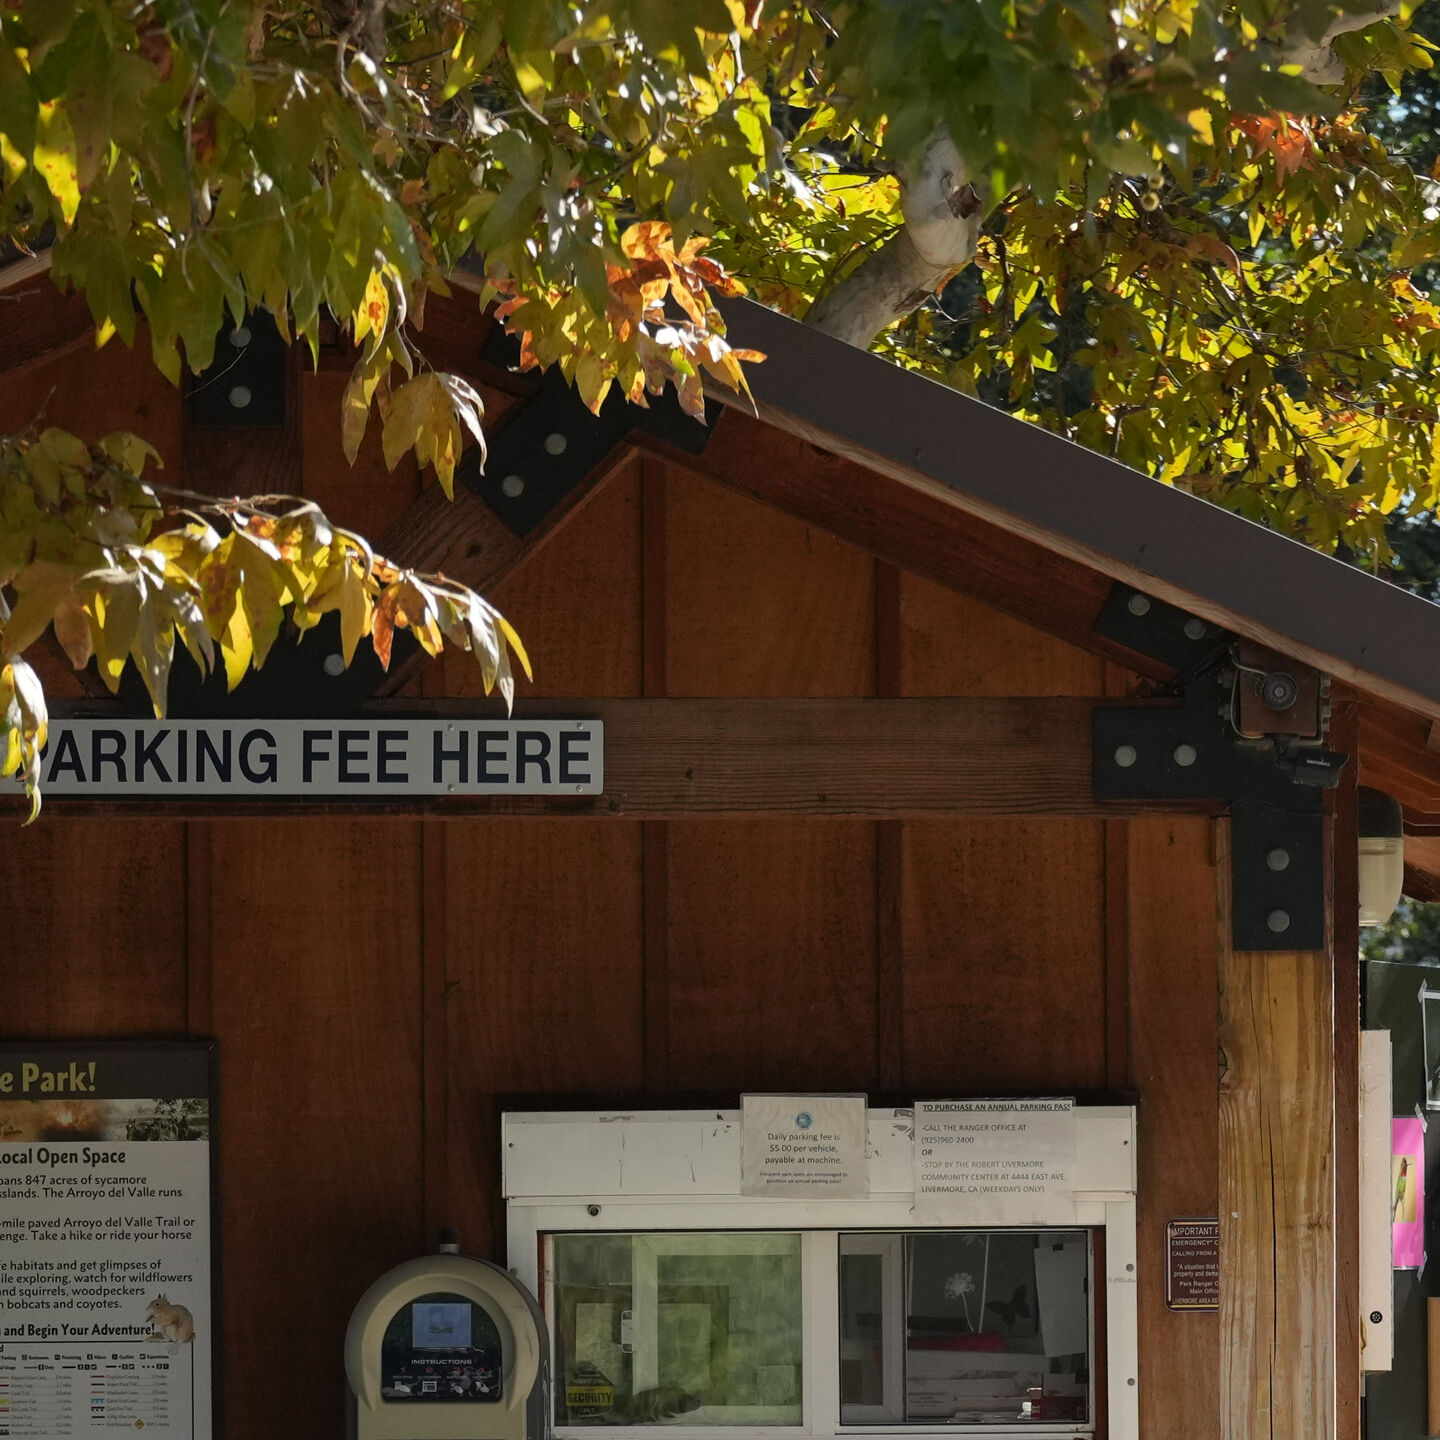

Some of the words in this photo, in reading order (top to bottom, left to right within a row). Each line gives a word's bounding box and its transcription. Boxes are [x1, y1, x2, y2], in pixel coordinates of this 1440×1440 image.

[15, 729, 278, 784] ARKING
[302, 730, 409, 783] FEE
[433, 730, 591, 784] HERE
[22, 1062, 96, 1092] Park!
[767, 1132, 787, 1141] Daily
[788, 1133, 818, 1141] parking
[769, 1144, 792, 1152] $5.00
[808, 1144, 838, 1153] vehicle,
[36, 1148, 77, 1166] Open
[82, 1147, 125, 1166] Space
[765, 1156, 795, 1165] payable
[25, 1174, 46, 1185] 847
[80, 1174, 92, 1184] of
[94, 1177, 146, 1186] sycamore
[921, 1173, 969, 1181] COMMUNITY
[42, 1187, 63, 1198] The
[66, 1186, 105, 1199] Arroyo
[107, 1187, 124, 1197] del
[127, 1186, 155, 1197] Valle
[921, 1185, 966, 1193] LIVERMORE,
[979, 1185, 1021, 1193] (WEEKDAYS
[10, 1260, 53, 1270] habitats
[56, 1260, 76, 1270] and
[79, 1261, 97, 1272] get
[99, 1259, 147, 1272] glimpses
[149, 1259, 161, 1269] of
[16, 1272, 71, 1285] exploring,
[73, 1272, 107, 1282] watch
[109, 1272, 126, 1282] for
[128, 1272, 192, 1282] wildflowers
[19, 1285, 68, 1298] squirrels,
[71, 1285, 145, 1297] woodpeckers
[7, 1298, 50, 1309] bobcats
[53, 1298, 73, 1308] and
[76, 1299, 121, 1310] coyotes.
[3, 1324, 24, 1336] and
[27, 1324, 57, 1338] Begin
[61, 1323, 88, 1335] Your
[91, 1323, 153, 1335] Adventure!
